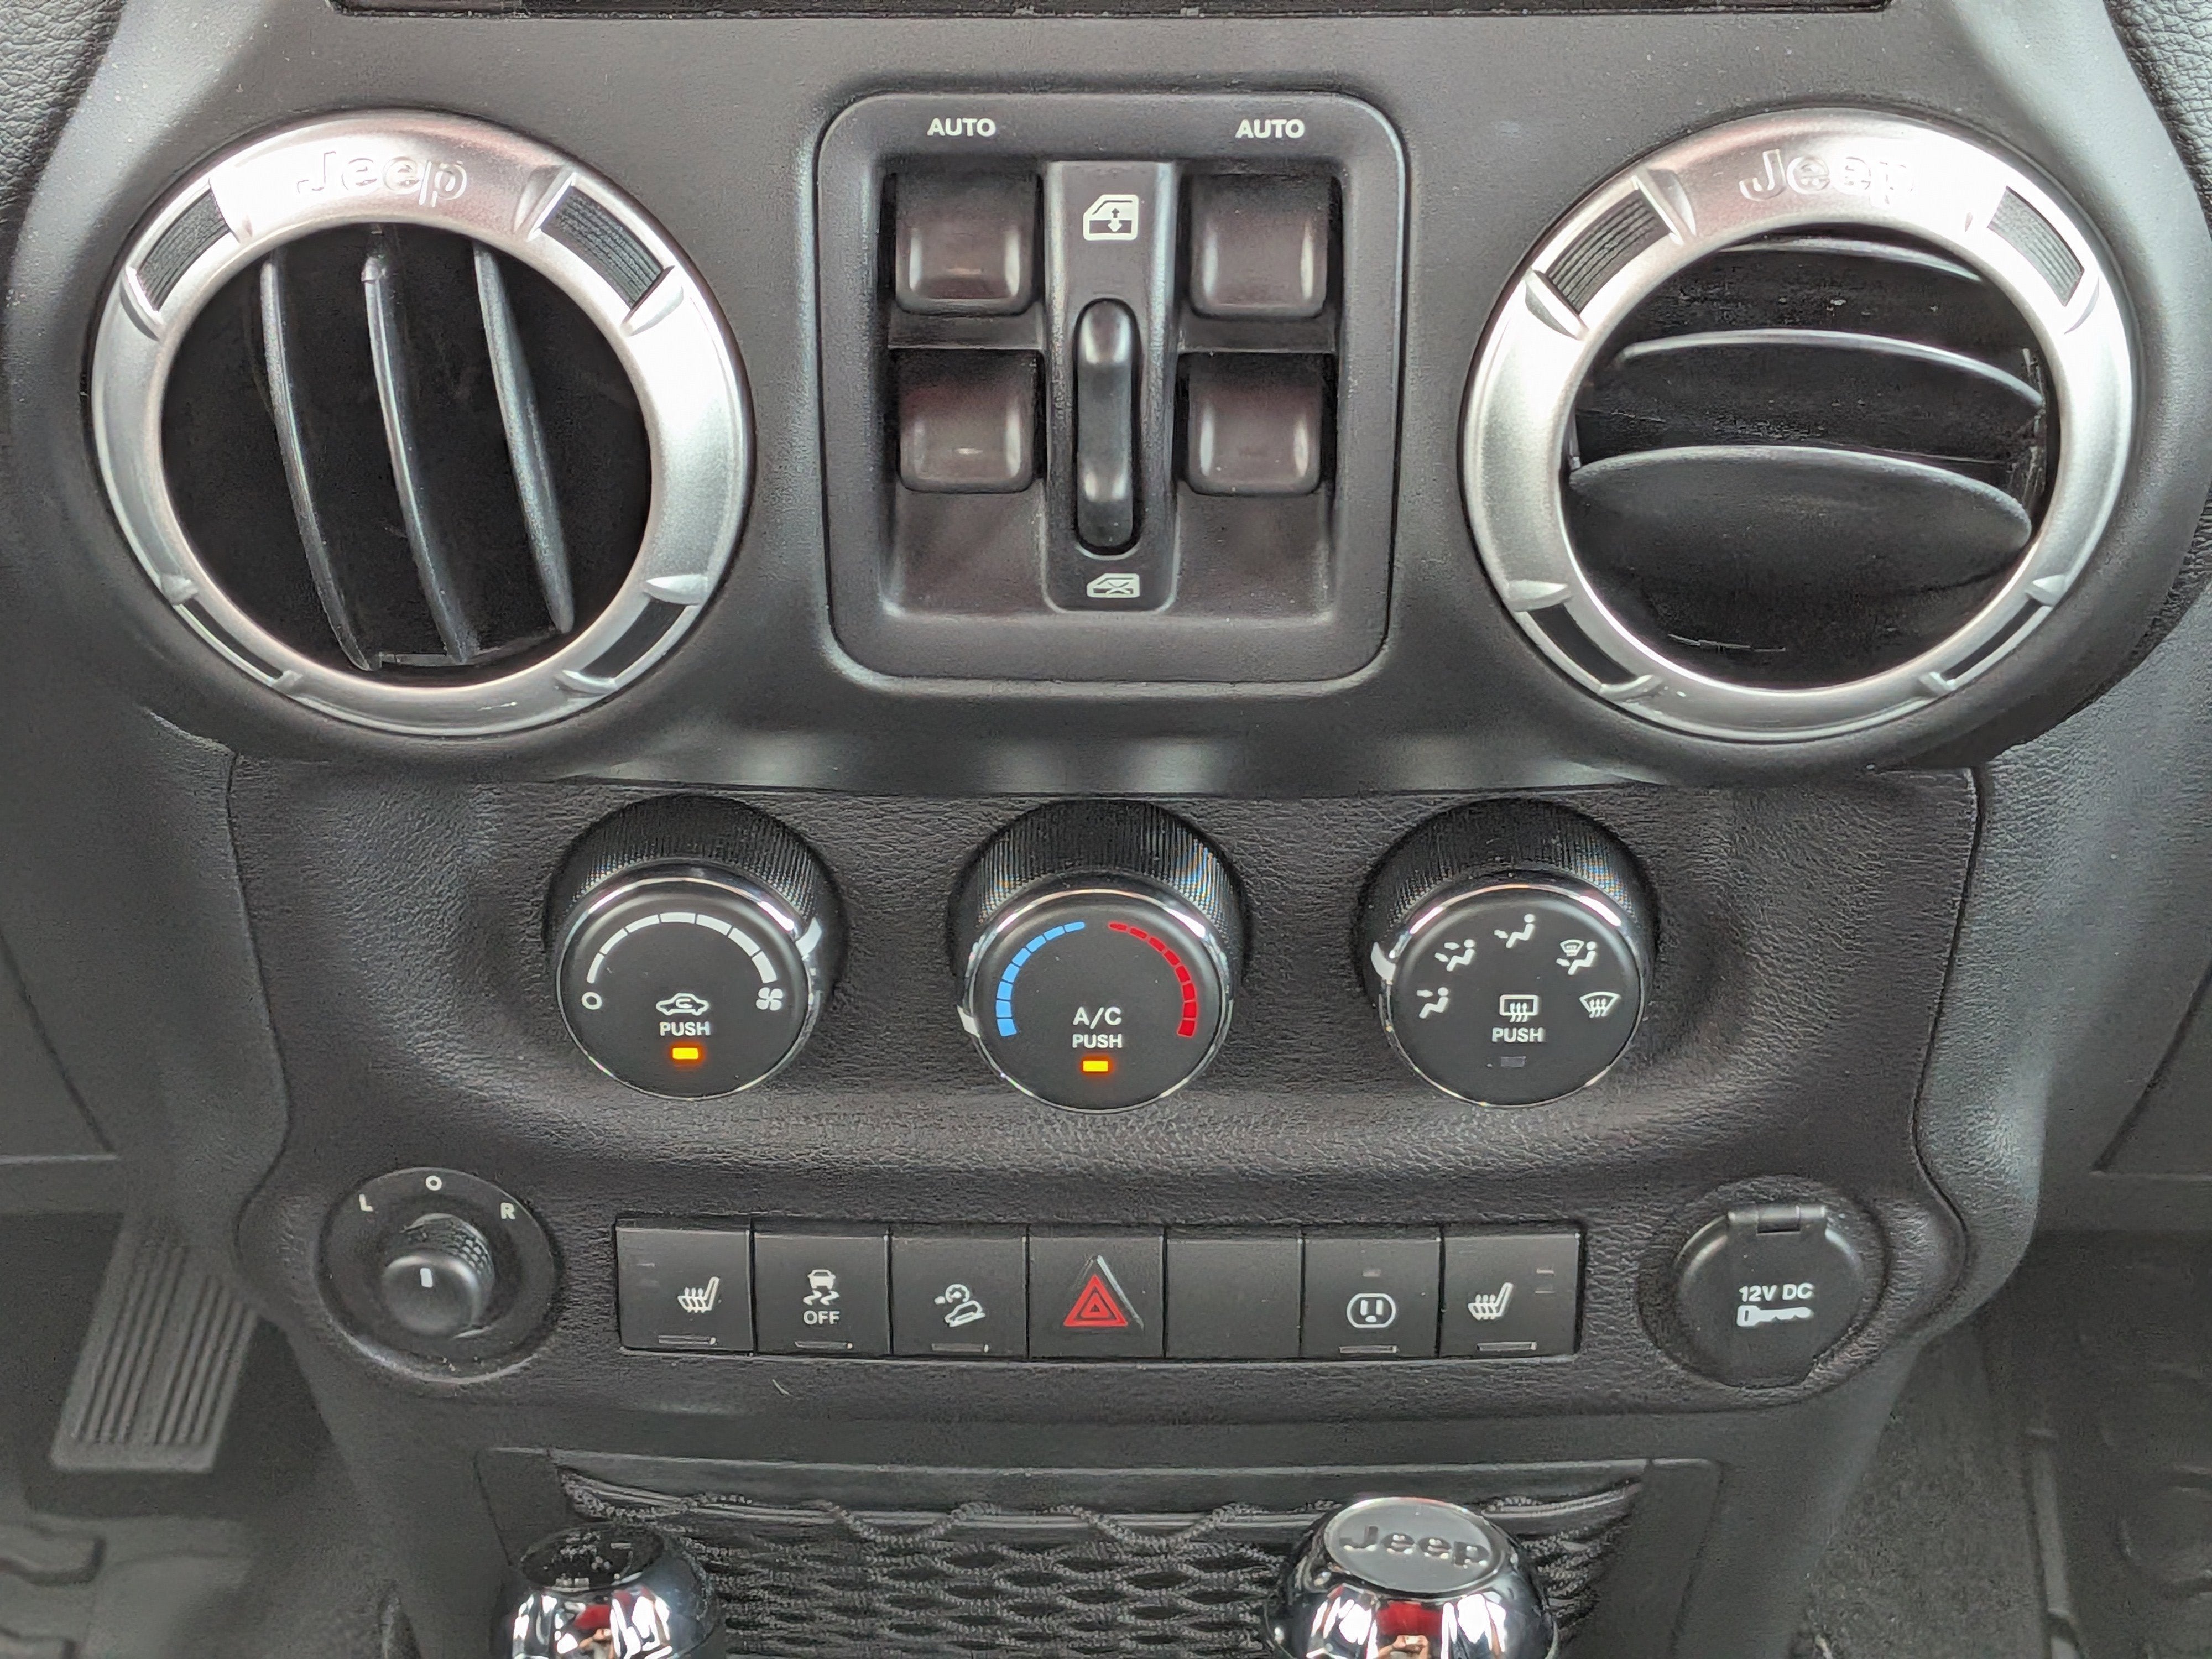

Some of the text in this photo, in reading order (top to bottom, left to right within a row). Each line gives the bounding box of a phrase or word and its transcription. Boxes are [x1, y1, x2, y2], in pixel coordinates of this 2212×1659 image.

[927, 118, 996, 137] AUTO
[1235, 119, 1305, 139] AUTO
[296, 150, 468, 208] Jeep
[1738, 148, 1916, 208] Jeep
[1072, 1006, 1123, 1029] A/C
[659, 1021, 711, 1036] PUSH
[1491, 1027, 1546, 1043] PUSH
[1072, 1034, 1123, 1049] PUSH
[359, 1194, 373, 1212] L
[500, 1202, 516, 1220] R
[1738, 1282, 1815, 1302] 12V DC
[803, 1310, 840, 1325] OFF
[1338, 1525, 1491, 1569] Jeep
